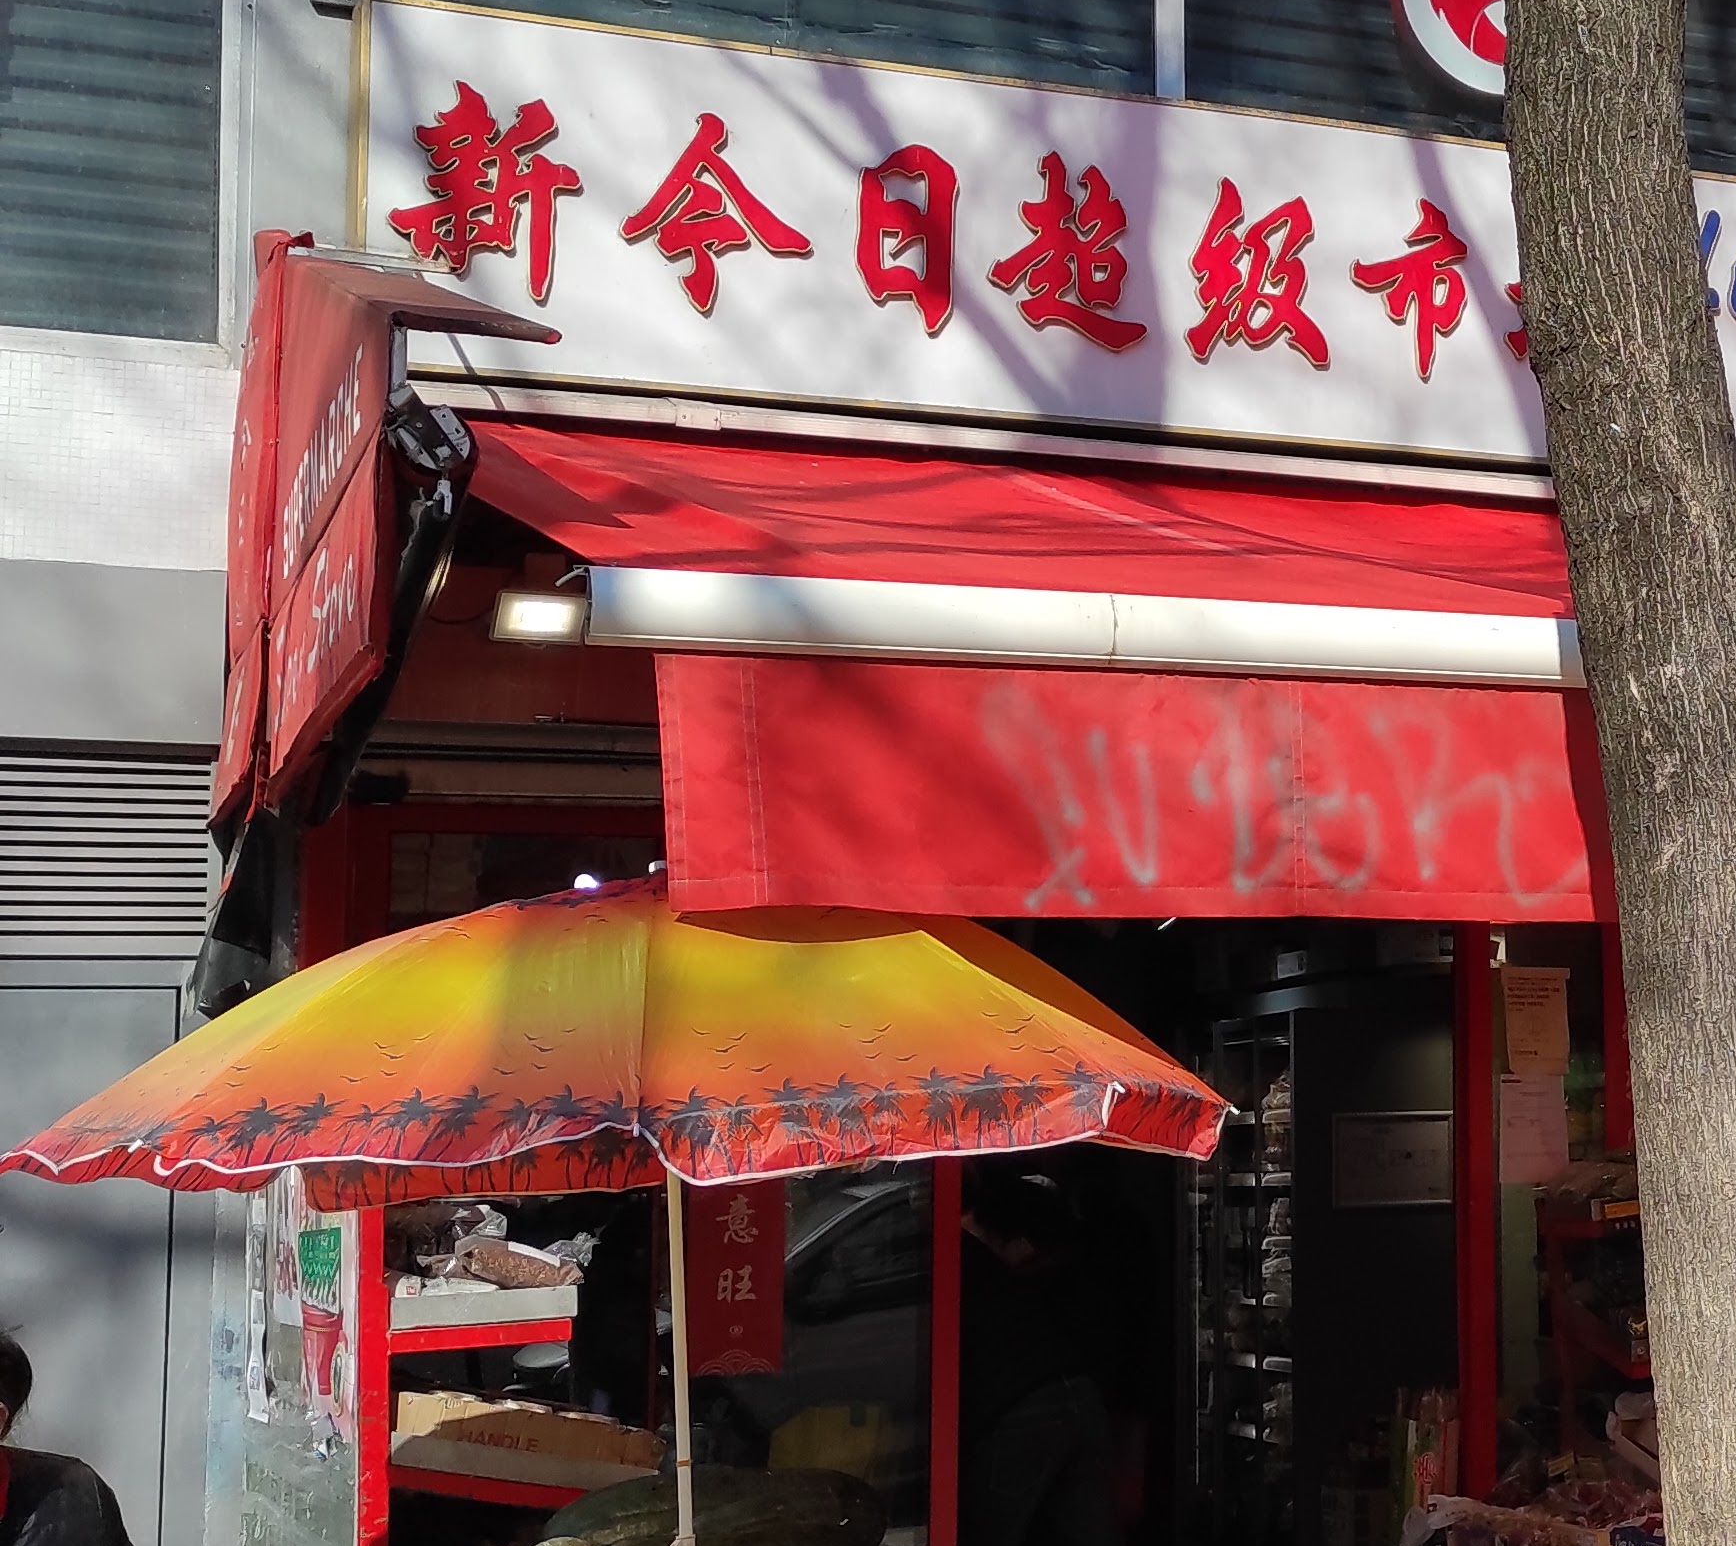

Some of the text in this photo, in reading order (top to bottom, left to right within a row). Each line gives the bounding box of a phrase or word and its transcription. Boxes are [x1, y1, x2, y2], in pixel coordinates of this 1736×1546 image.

[386, 79, 1530, 383] 新今日超级市
[456, 1430, 542, 1452] HANDLE
